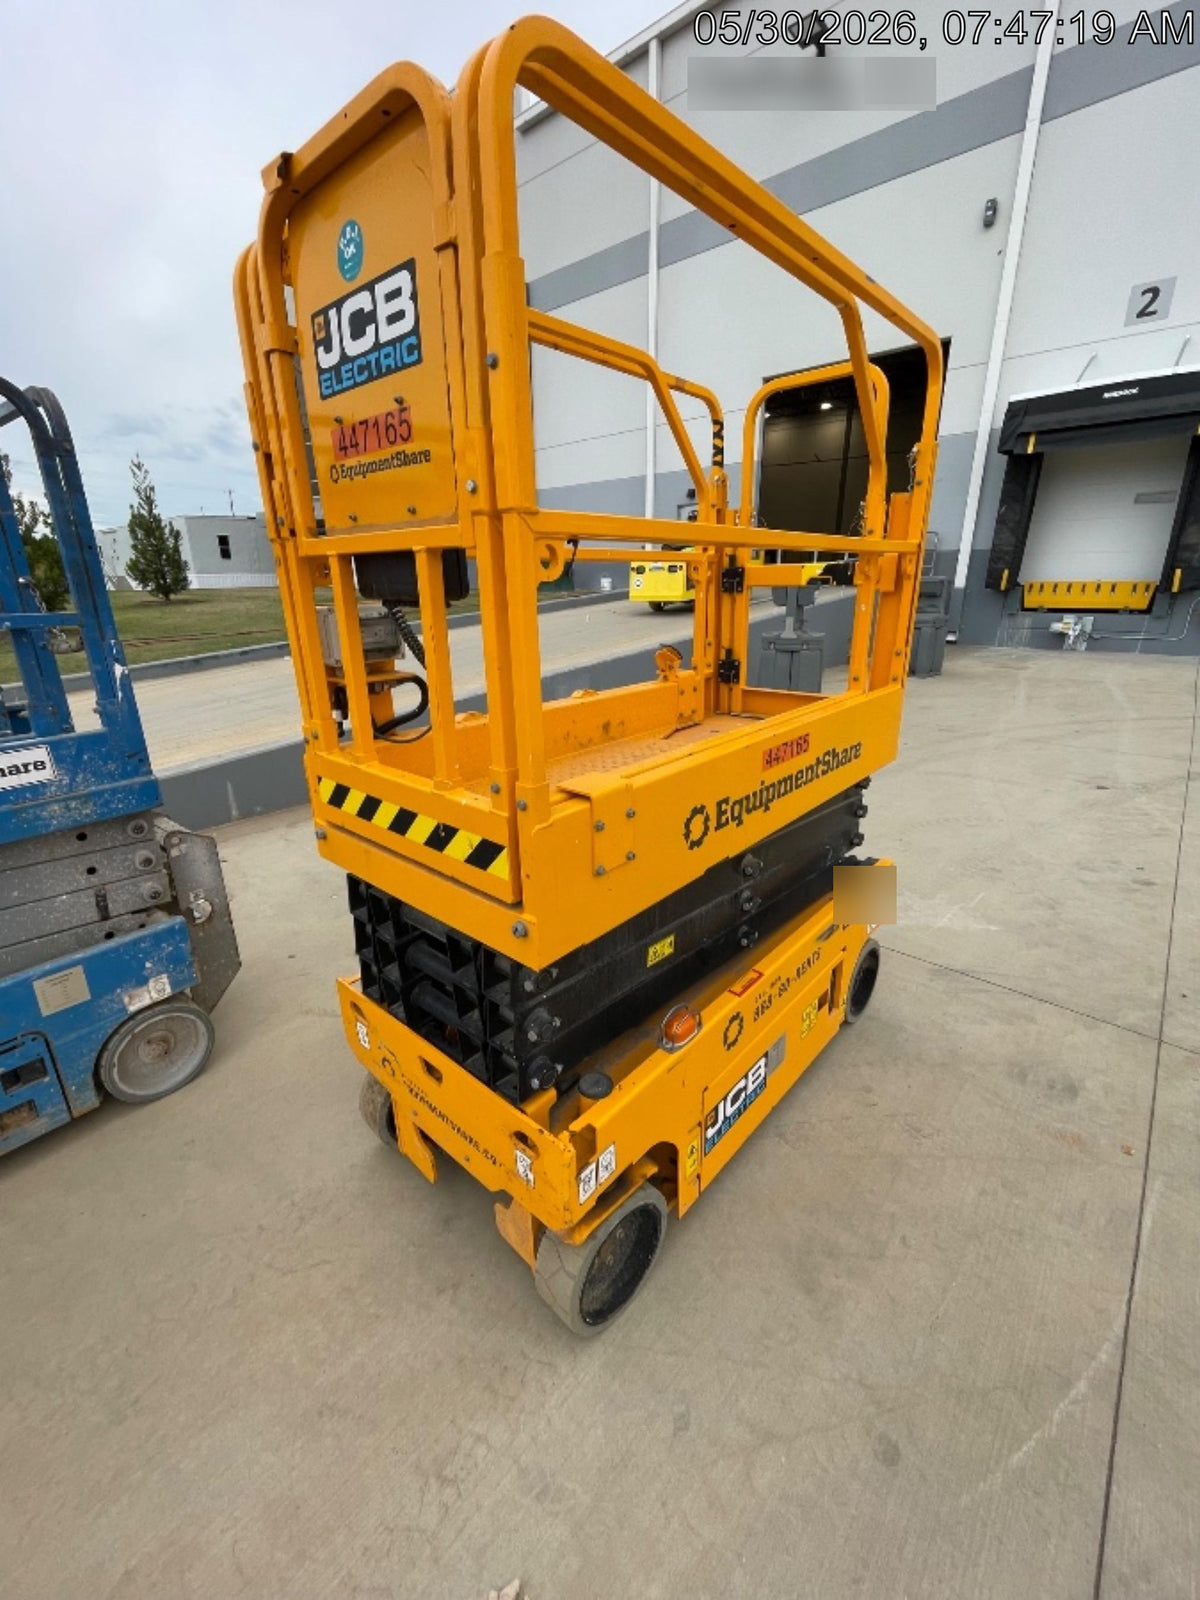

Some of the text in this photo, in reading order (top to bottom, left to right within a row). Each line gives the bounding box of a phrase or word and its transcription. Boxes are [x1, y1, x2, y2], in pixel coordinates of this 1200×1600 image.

[317, 269, 415, 369] JCB
[1136, 285, 1160, 319] 2
[320, 336, 419, 395] ELECTRIC
[338, 406, 411, 457] 447165
[340, 449, 431, 480] EquipmentShare
[765, 732, 809, 768] 447165
[714, 741, 862, 832] EquipmentShare
[706, 1056, 767, 1139] JCB
